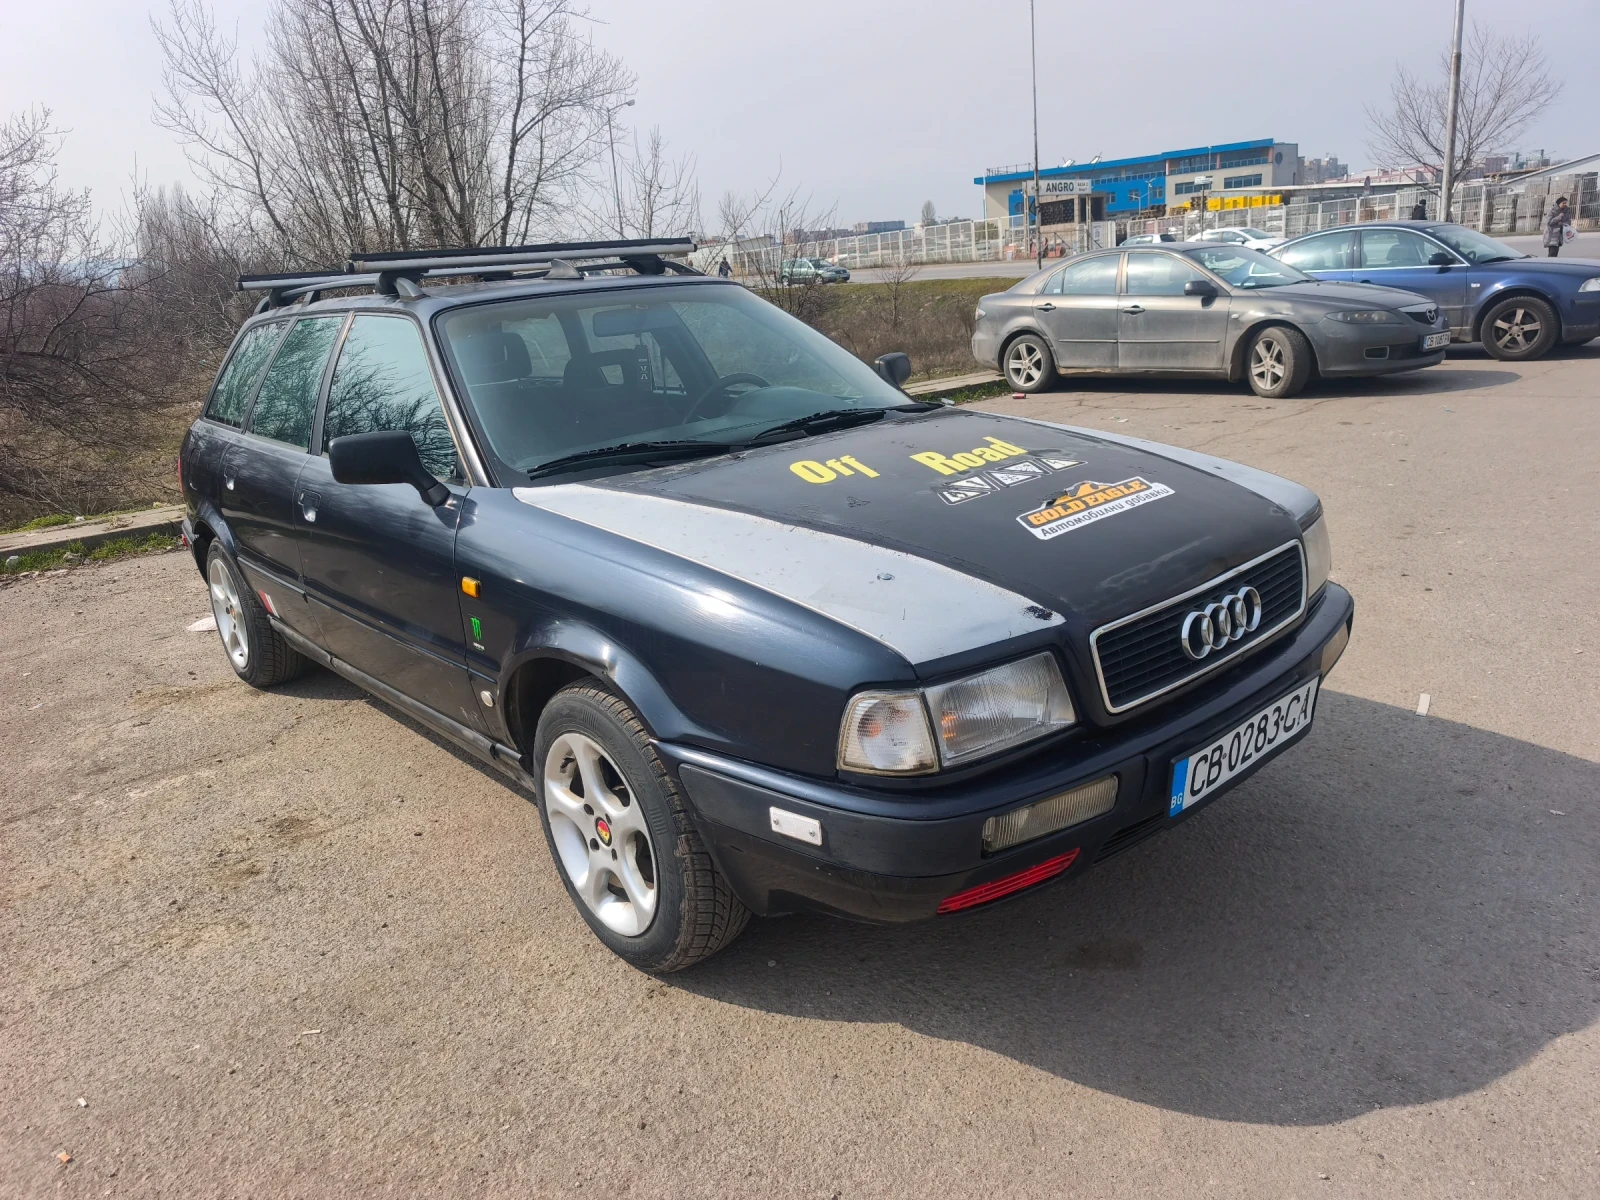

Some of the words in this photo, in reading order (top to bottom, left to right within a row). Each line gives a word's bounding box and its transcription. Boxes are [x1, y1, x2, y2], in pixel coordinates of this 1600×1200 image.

[1046, 182, 1074, 192] ANGRO
[789, 455, 880, 484] Off
[909, 436, 1029, 476] Road
[1027, 500, 1087, 526] GOLD
[1087, 480, 1148, 506] EAGLE
[1041, 502, 1125, 537] Автомобилни
[1125, 487, 1170, 507] добавки
[1170, 792, 1183, 810] BG
